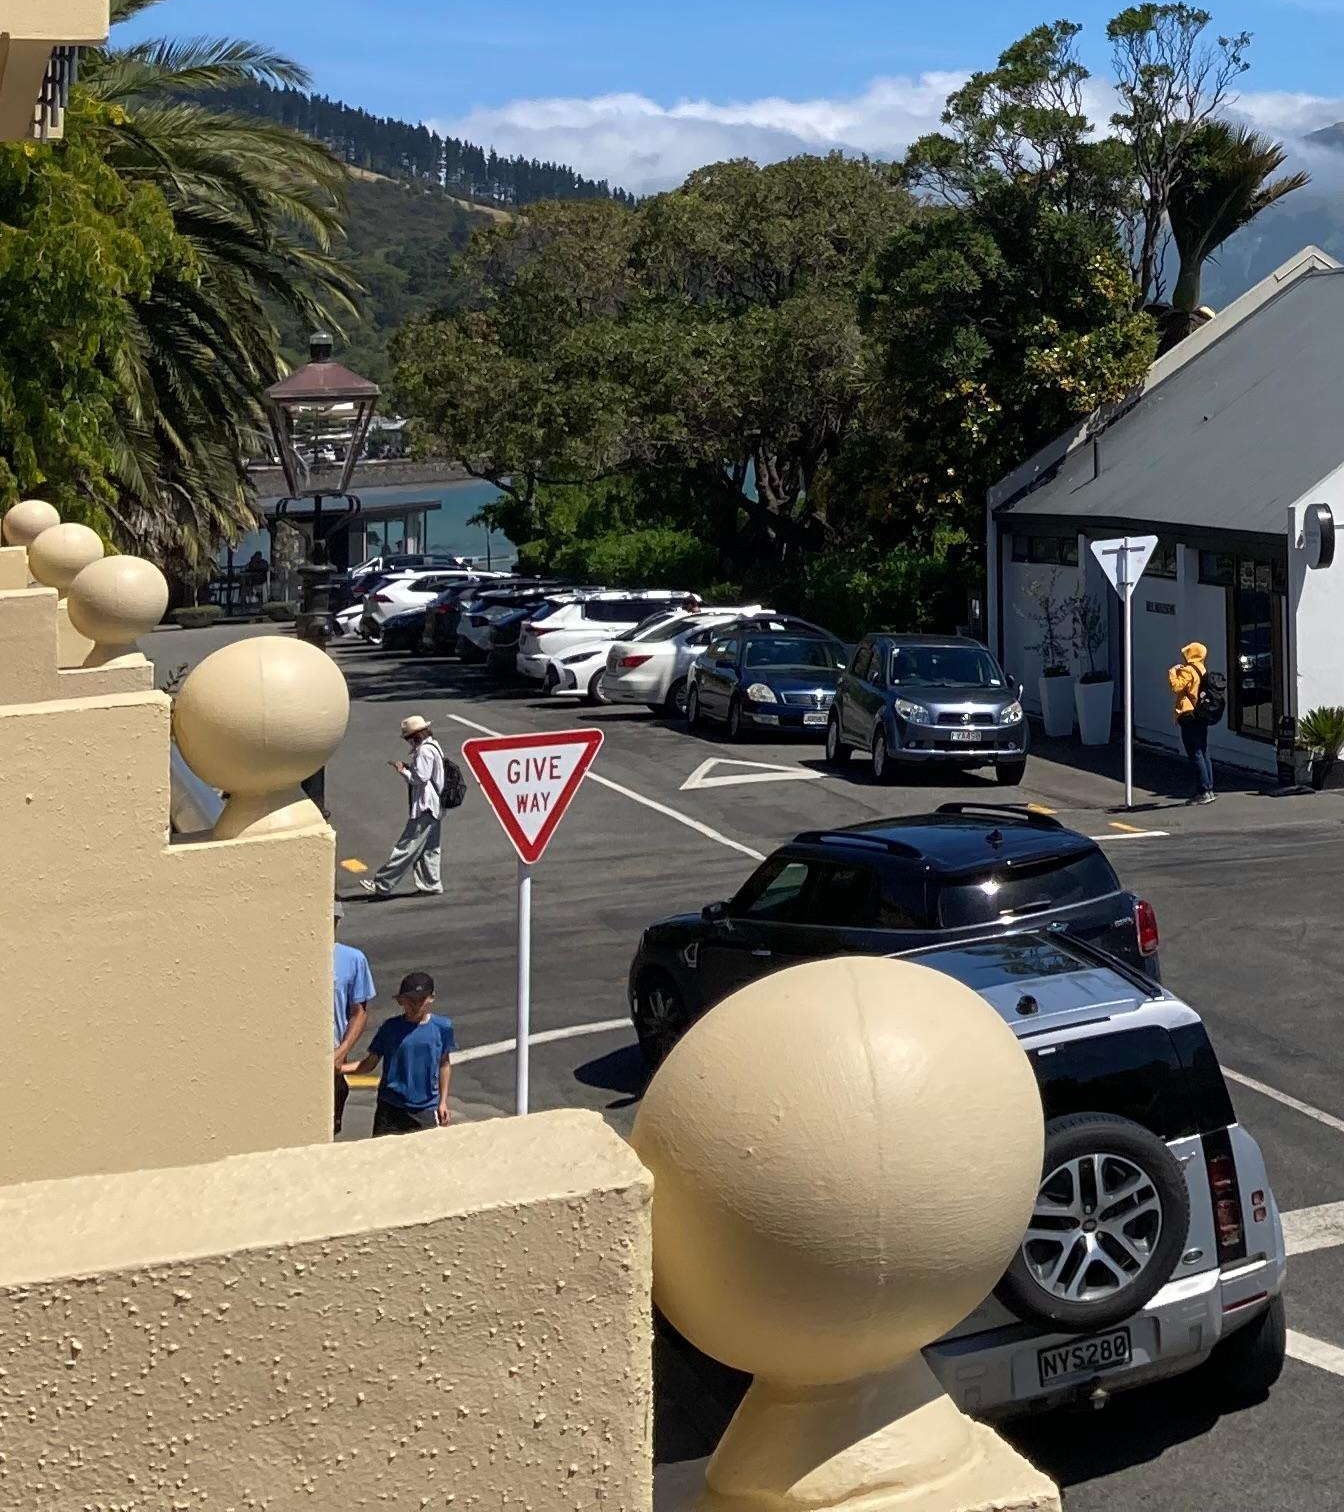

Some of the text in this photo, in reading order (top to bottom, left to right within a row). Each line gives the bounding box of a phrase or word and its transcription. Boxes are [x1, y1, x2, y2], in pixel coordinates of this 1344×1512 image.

[507, 755, 562, 784] GIVE
[517, 791, 551, 814] WAY
[1043, 1336, 1127, 1377] NYS280
